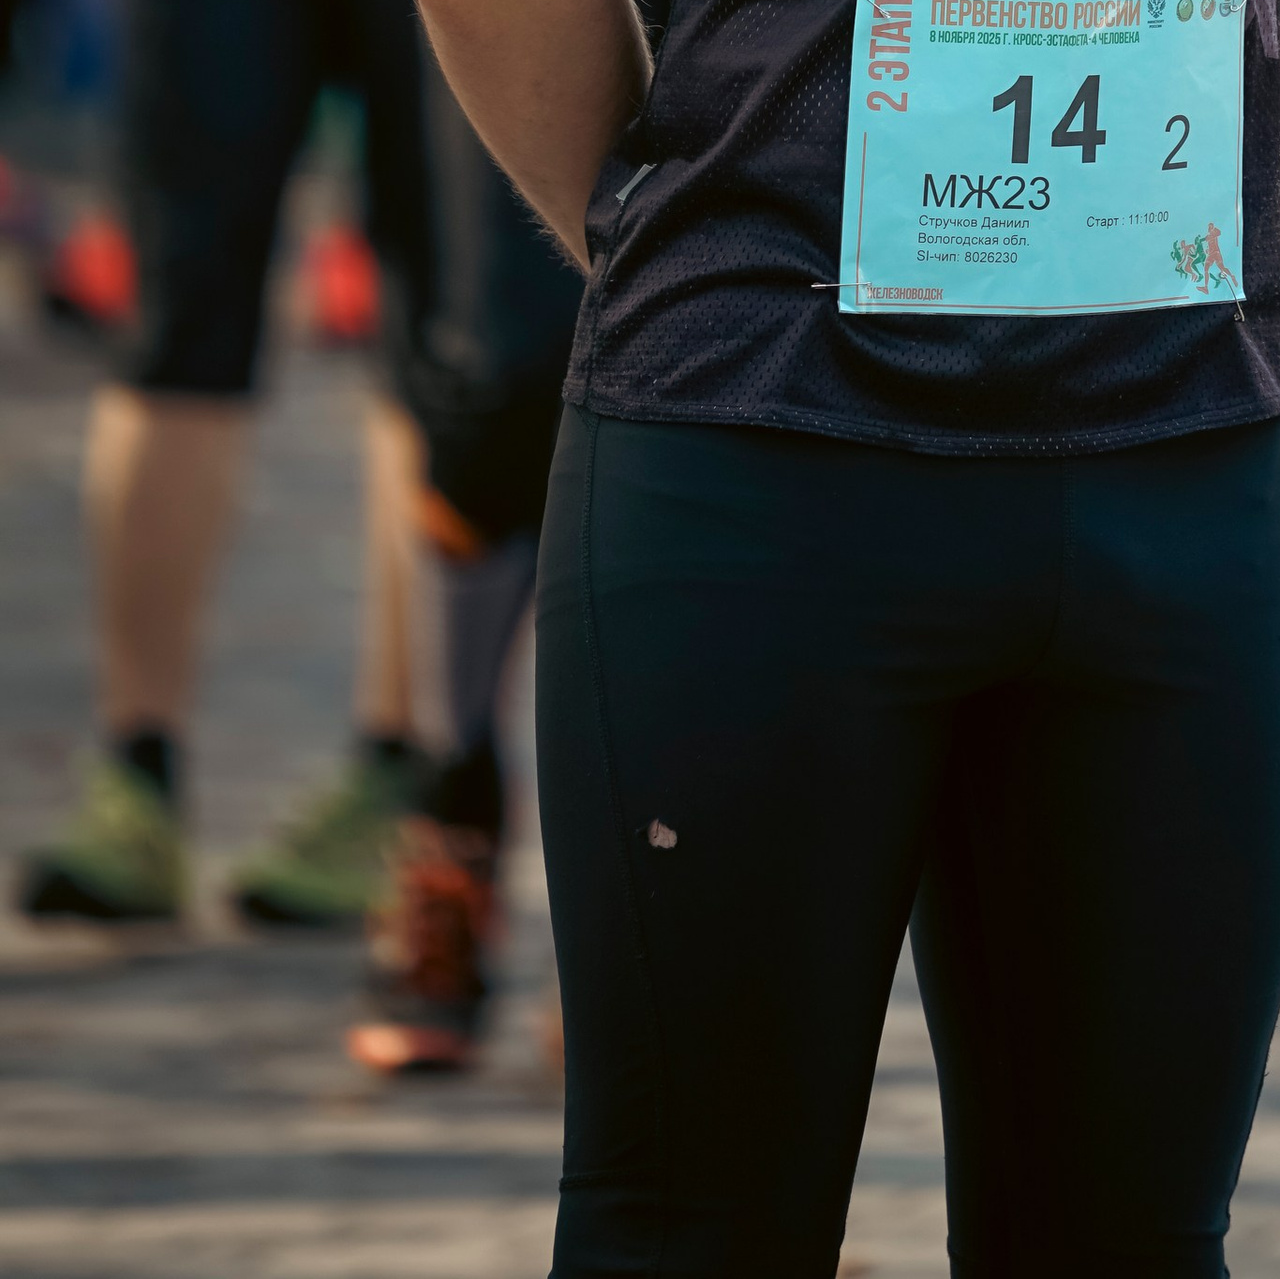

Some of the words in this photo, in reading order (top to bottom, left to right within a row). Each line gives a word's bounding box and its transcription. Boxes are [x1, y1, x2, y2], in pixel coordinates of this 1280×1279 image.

[1073, 0, 1141, 30] РОССИИ
[929, 30, 936, 43] 8
[938, 31, 975, 44] НОЯБРЯ
[977, 32, 1001, 45] 2025
[1099, 31, 1140, 45] ЧЕЛОВЕКА
[866, 91, 908, 112] 2
[992, 75, 1106, 164] 14
[1162, 115, 1190, 171] 2
[923, 173, 1051, 211] МЖ23
[919, 215, 978, 230] Стручков
[981, 216, 1030, 230] Даниил
[1086, 216, 1119, 229] Старт
[1129, 210, 1170, 225] 11:10:00
[918, 232, 999, 246] Вологодская
[1002, 234, 1030, 247] обл.
[916, 250, 960, 262] SI-чип:
[964, 251, 1018, 263] 8026230
